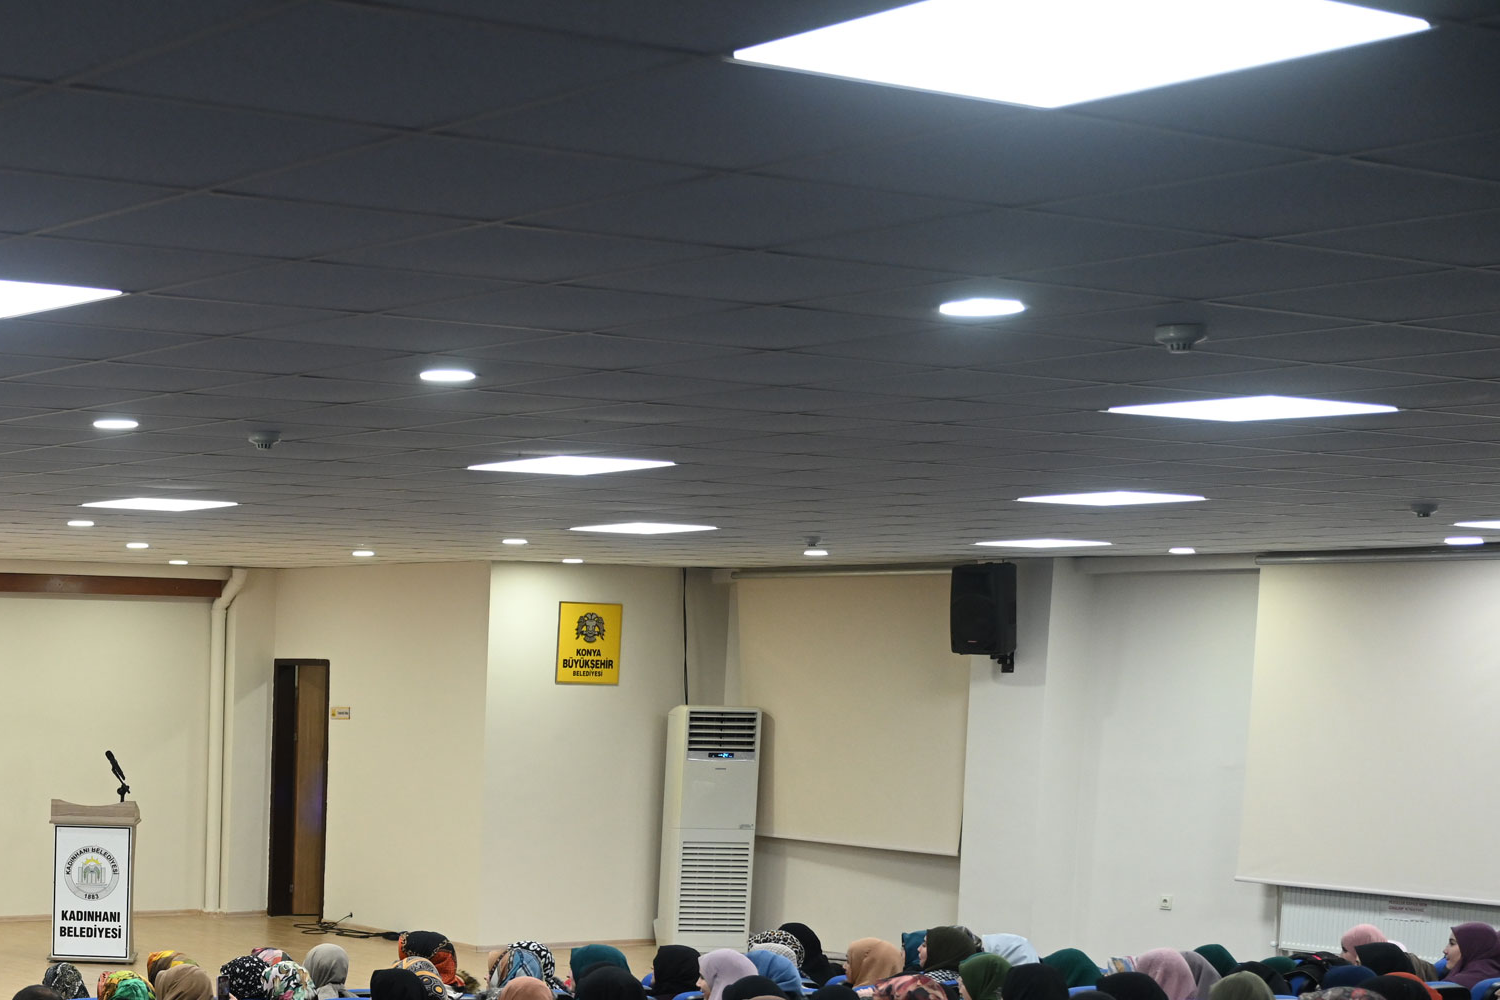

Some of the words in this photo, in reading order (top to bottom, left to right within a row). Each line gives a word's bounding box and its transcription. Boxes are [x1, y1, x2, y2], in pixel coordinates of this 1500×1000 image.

[576, 648, 601, 657] KONYA
[562, 657, 614, 670] BÜYÜKŞEHİR
[61, 910, 121, 923] KADINHANI
[59, 924, 122, 939] BELEDİYESİ
